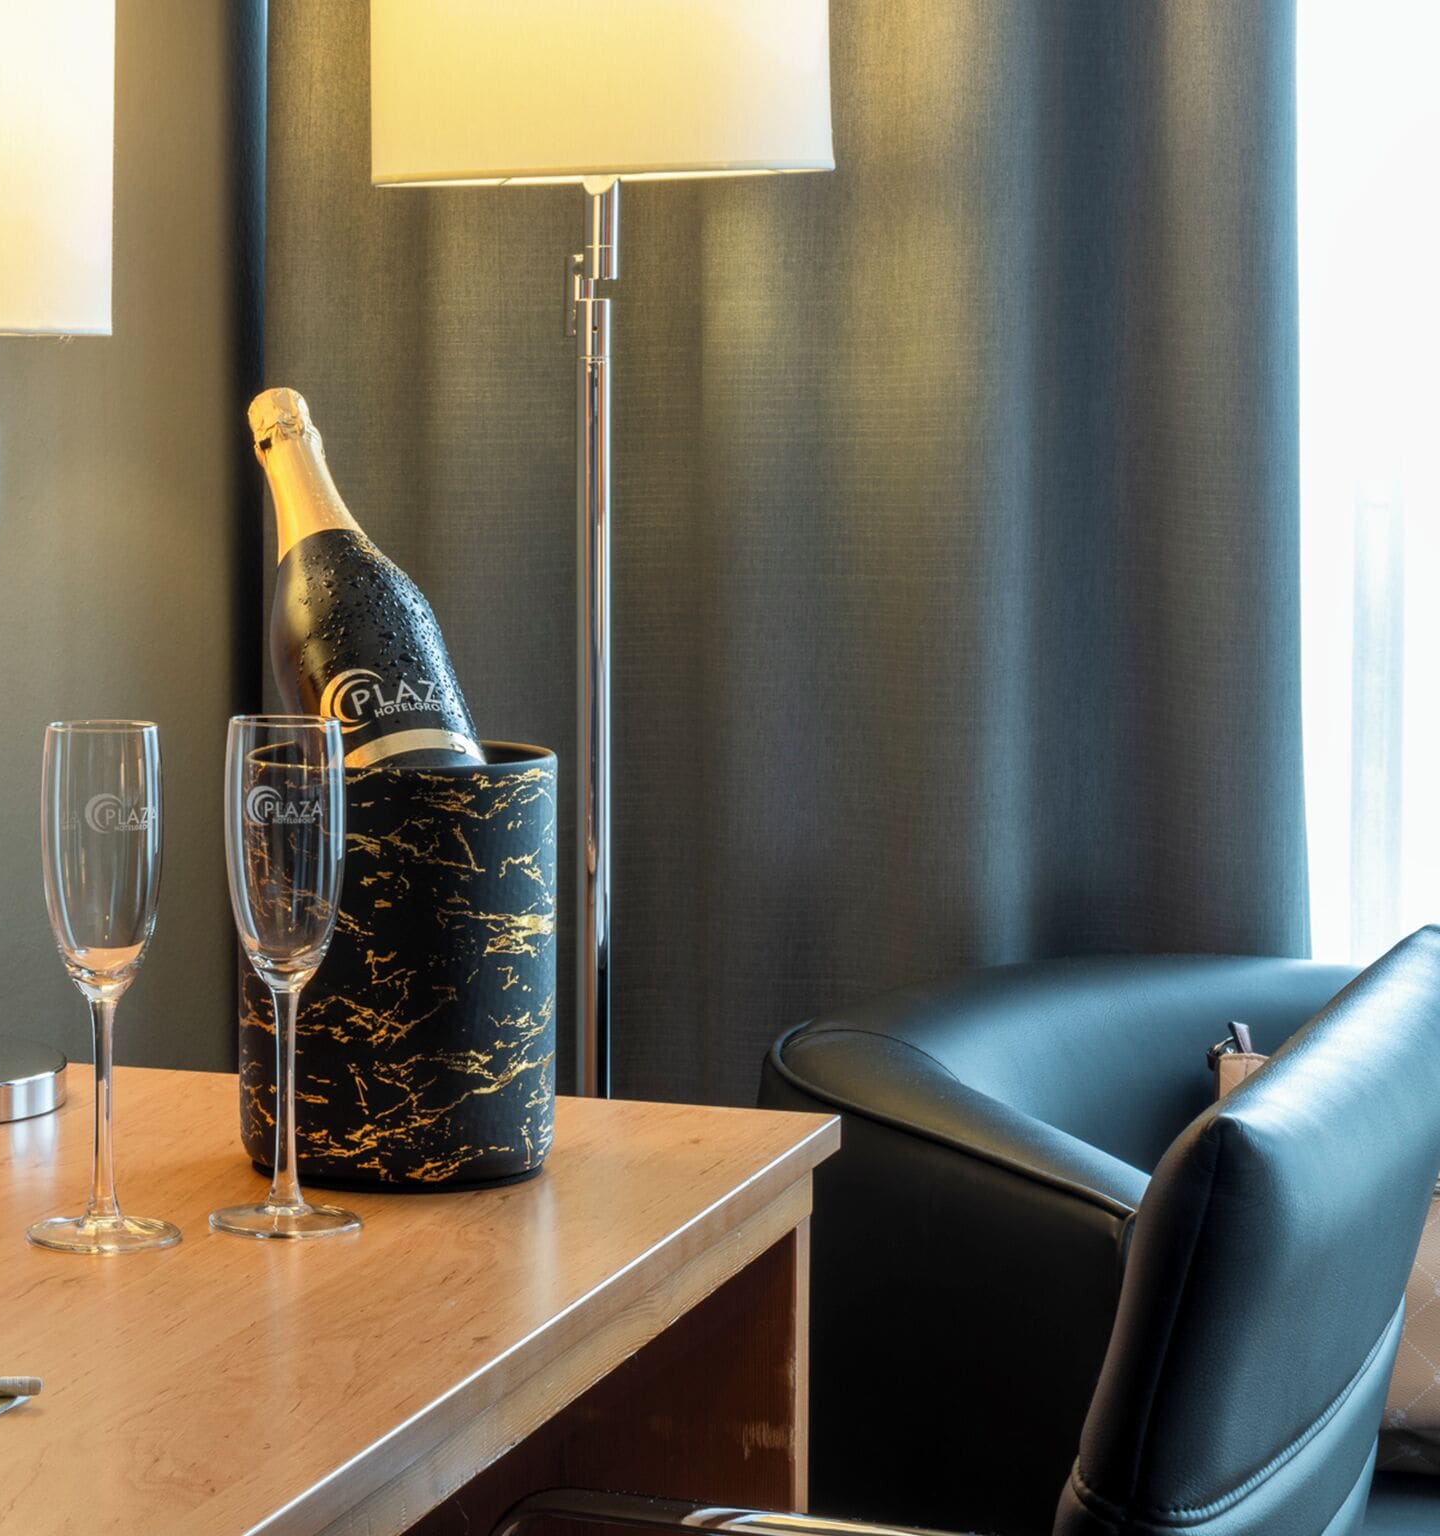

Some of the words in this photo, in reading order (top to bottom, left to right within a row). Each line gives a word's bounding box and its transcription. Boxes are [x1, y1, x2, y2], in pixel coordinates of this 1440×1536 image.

[351, 679, 440, 716] PLAZ
[374, 702, 441, 718] HOTELGRO
[105, 807, 157, 826] PLAZA
[264, 800, 323, 818] PLAZA
